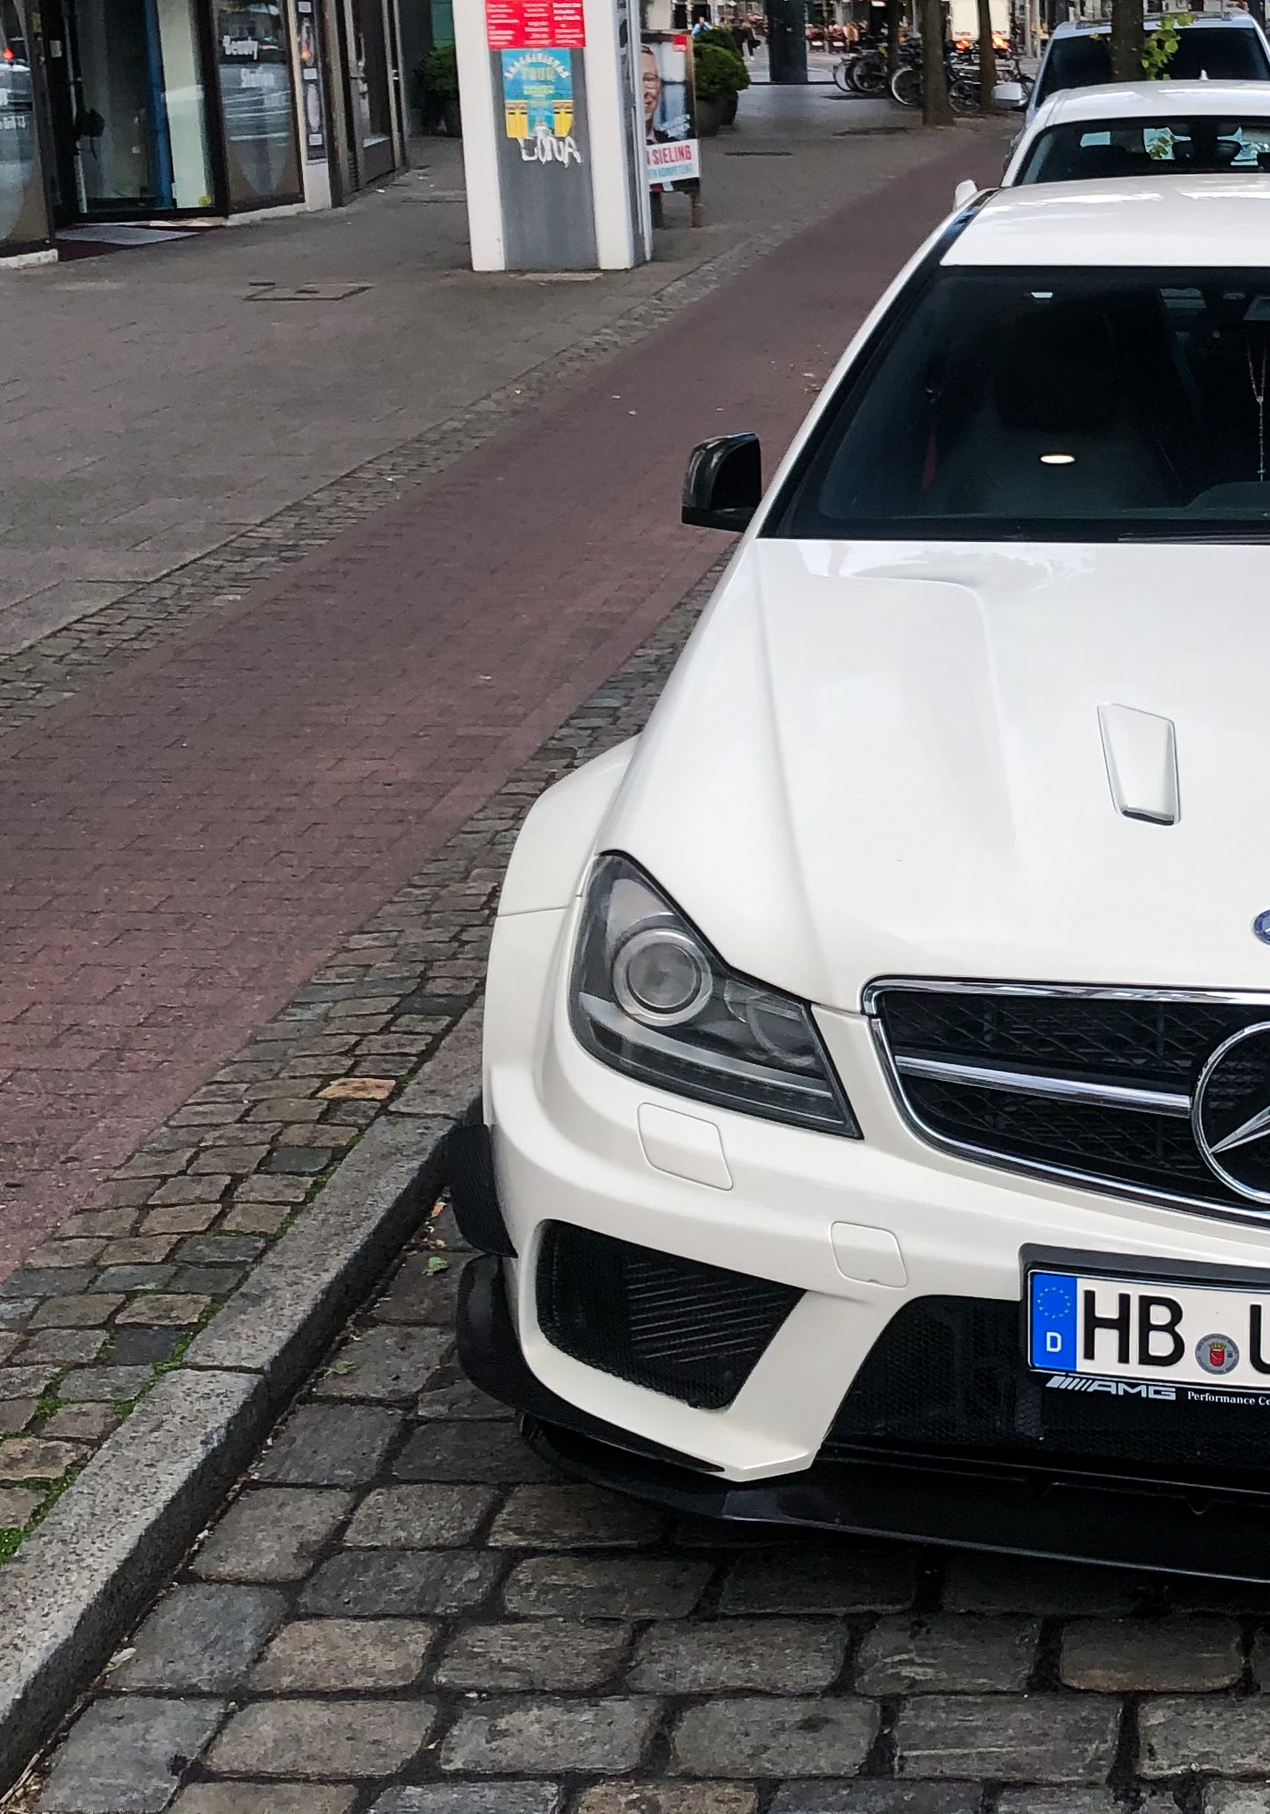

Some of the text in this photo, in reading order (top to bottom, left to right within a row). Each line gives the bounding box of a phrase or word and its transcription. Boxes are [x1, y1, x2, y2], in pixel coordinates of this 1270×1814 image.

[652, 145, 692, 165] SIELING
[1082, 1289, 1186, 1368] HB
[1046, 1331, 1062, 1353] D
[1086, 1380, 1176, 1400] AMG
[1187, 1390, 1256, 1406] Performance
